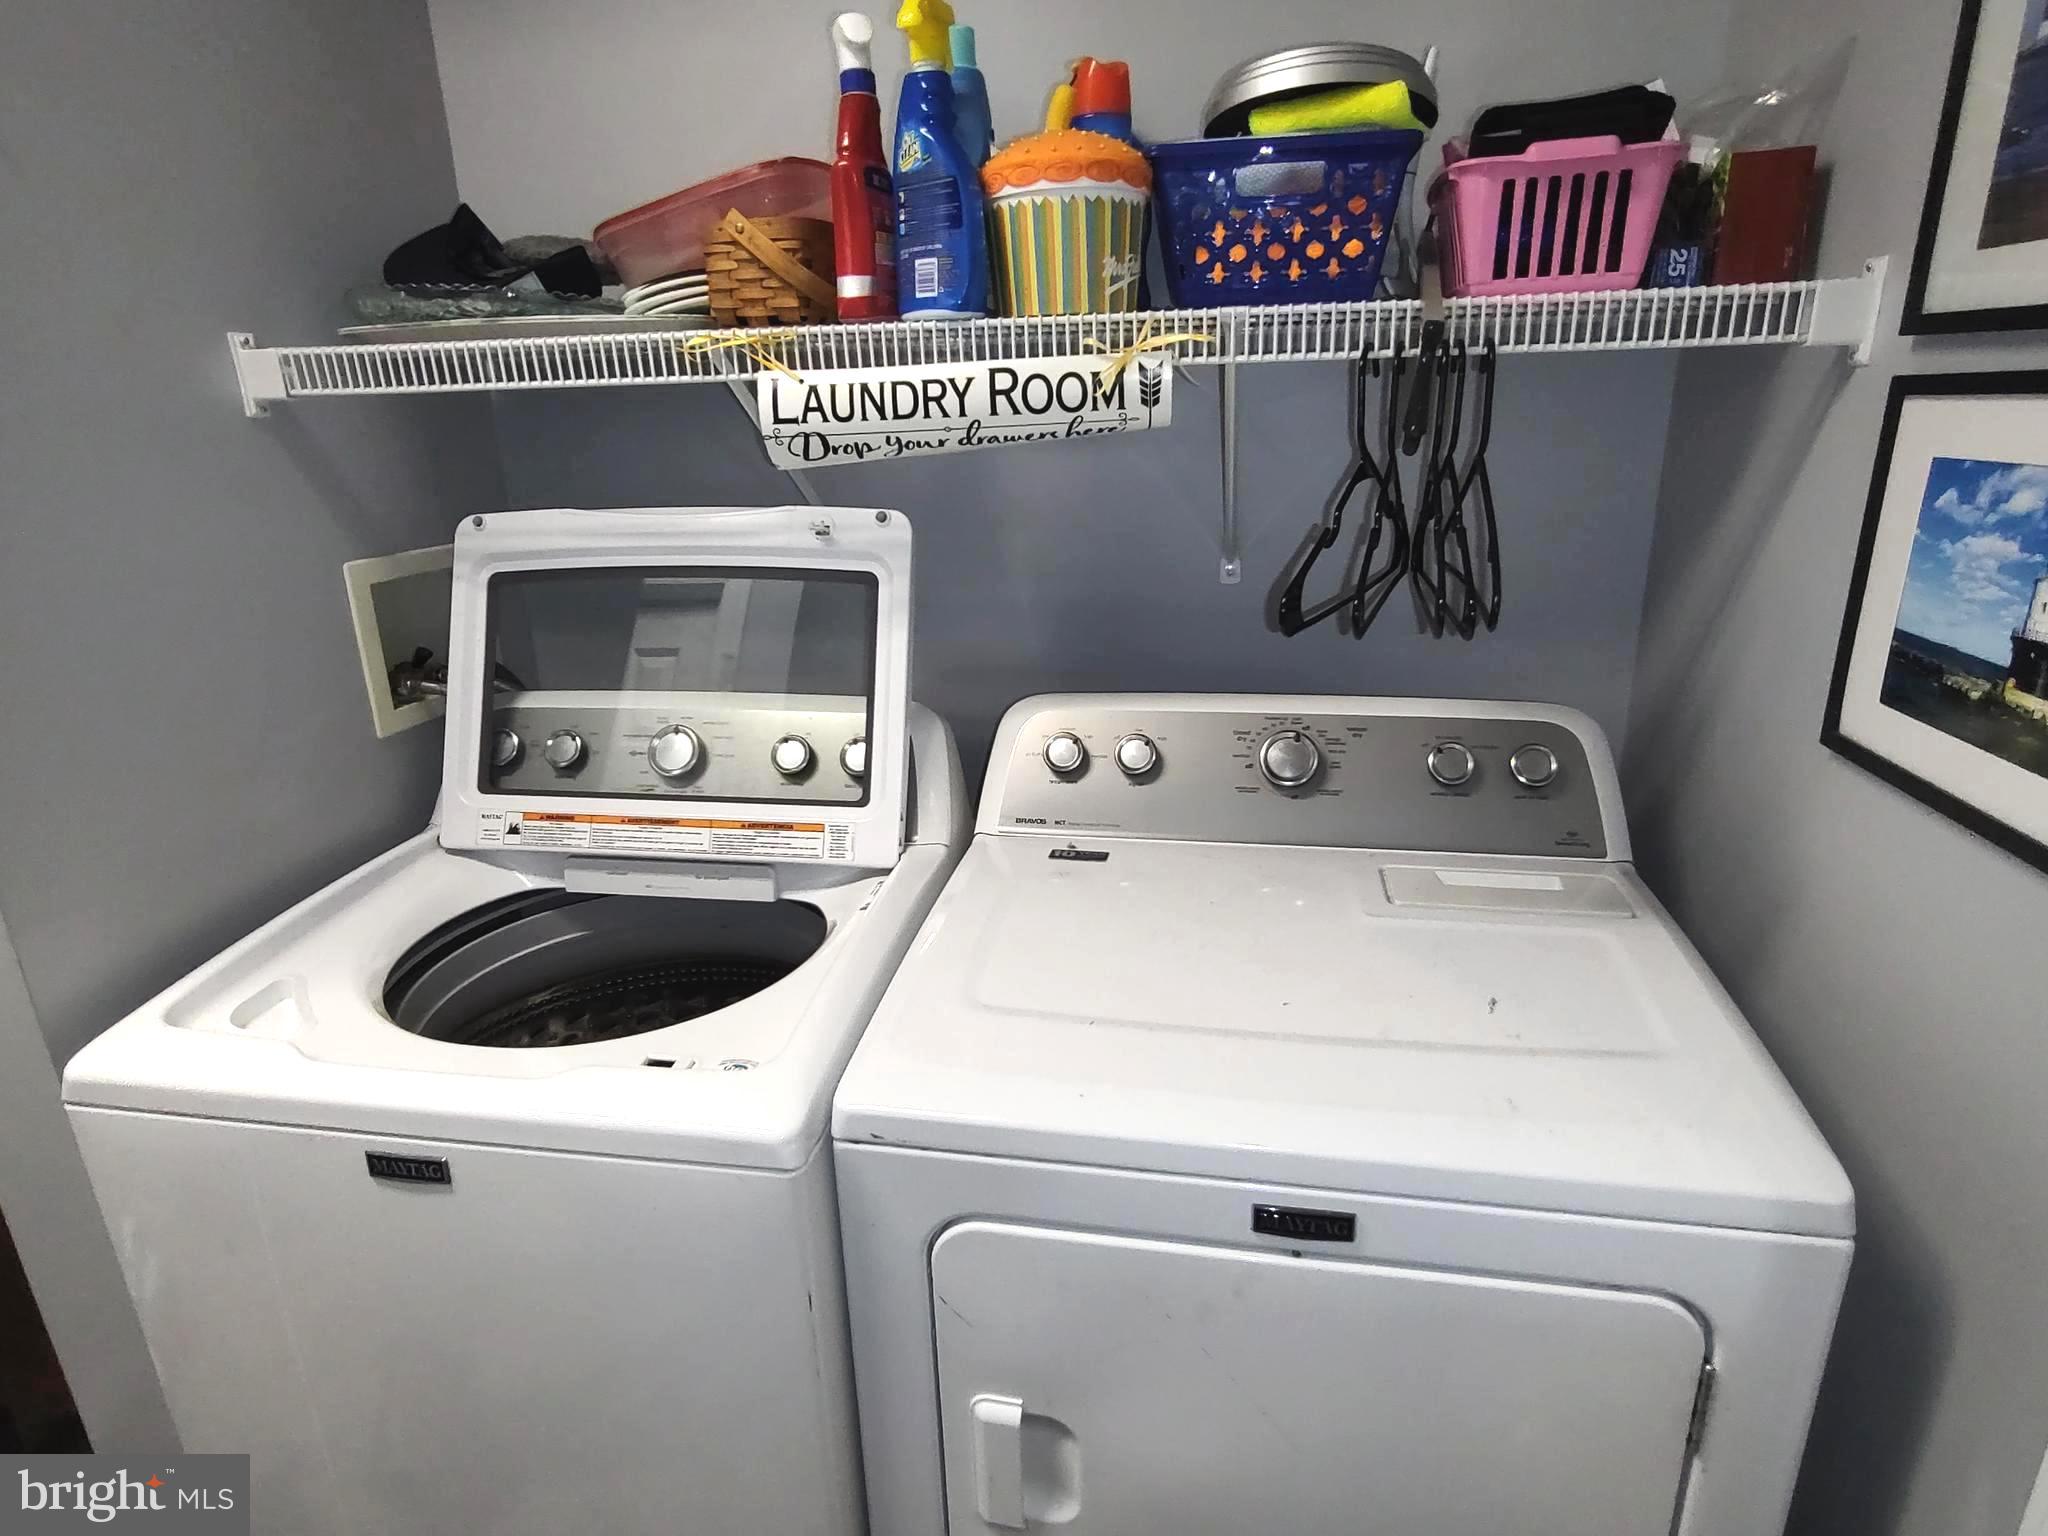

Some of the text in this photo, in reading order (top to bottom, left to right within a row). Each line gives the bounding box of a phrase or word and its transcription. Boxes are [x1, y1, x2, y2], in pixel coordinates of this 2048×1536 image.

[1667, 248, 1689, 277] 25
[771, 366, 1127, 426] LAUNDRY ROOM
[788, 431, 881, 461] Drop
[883, 435, 950, 457] your
[369, 1158, 442, 1179] MAYTAG
